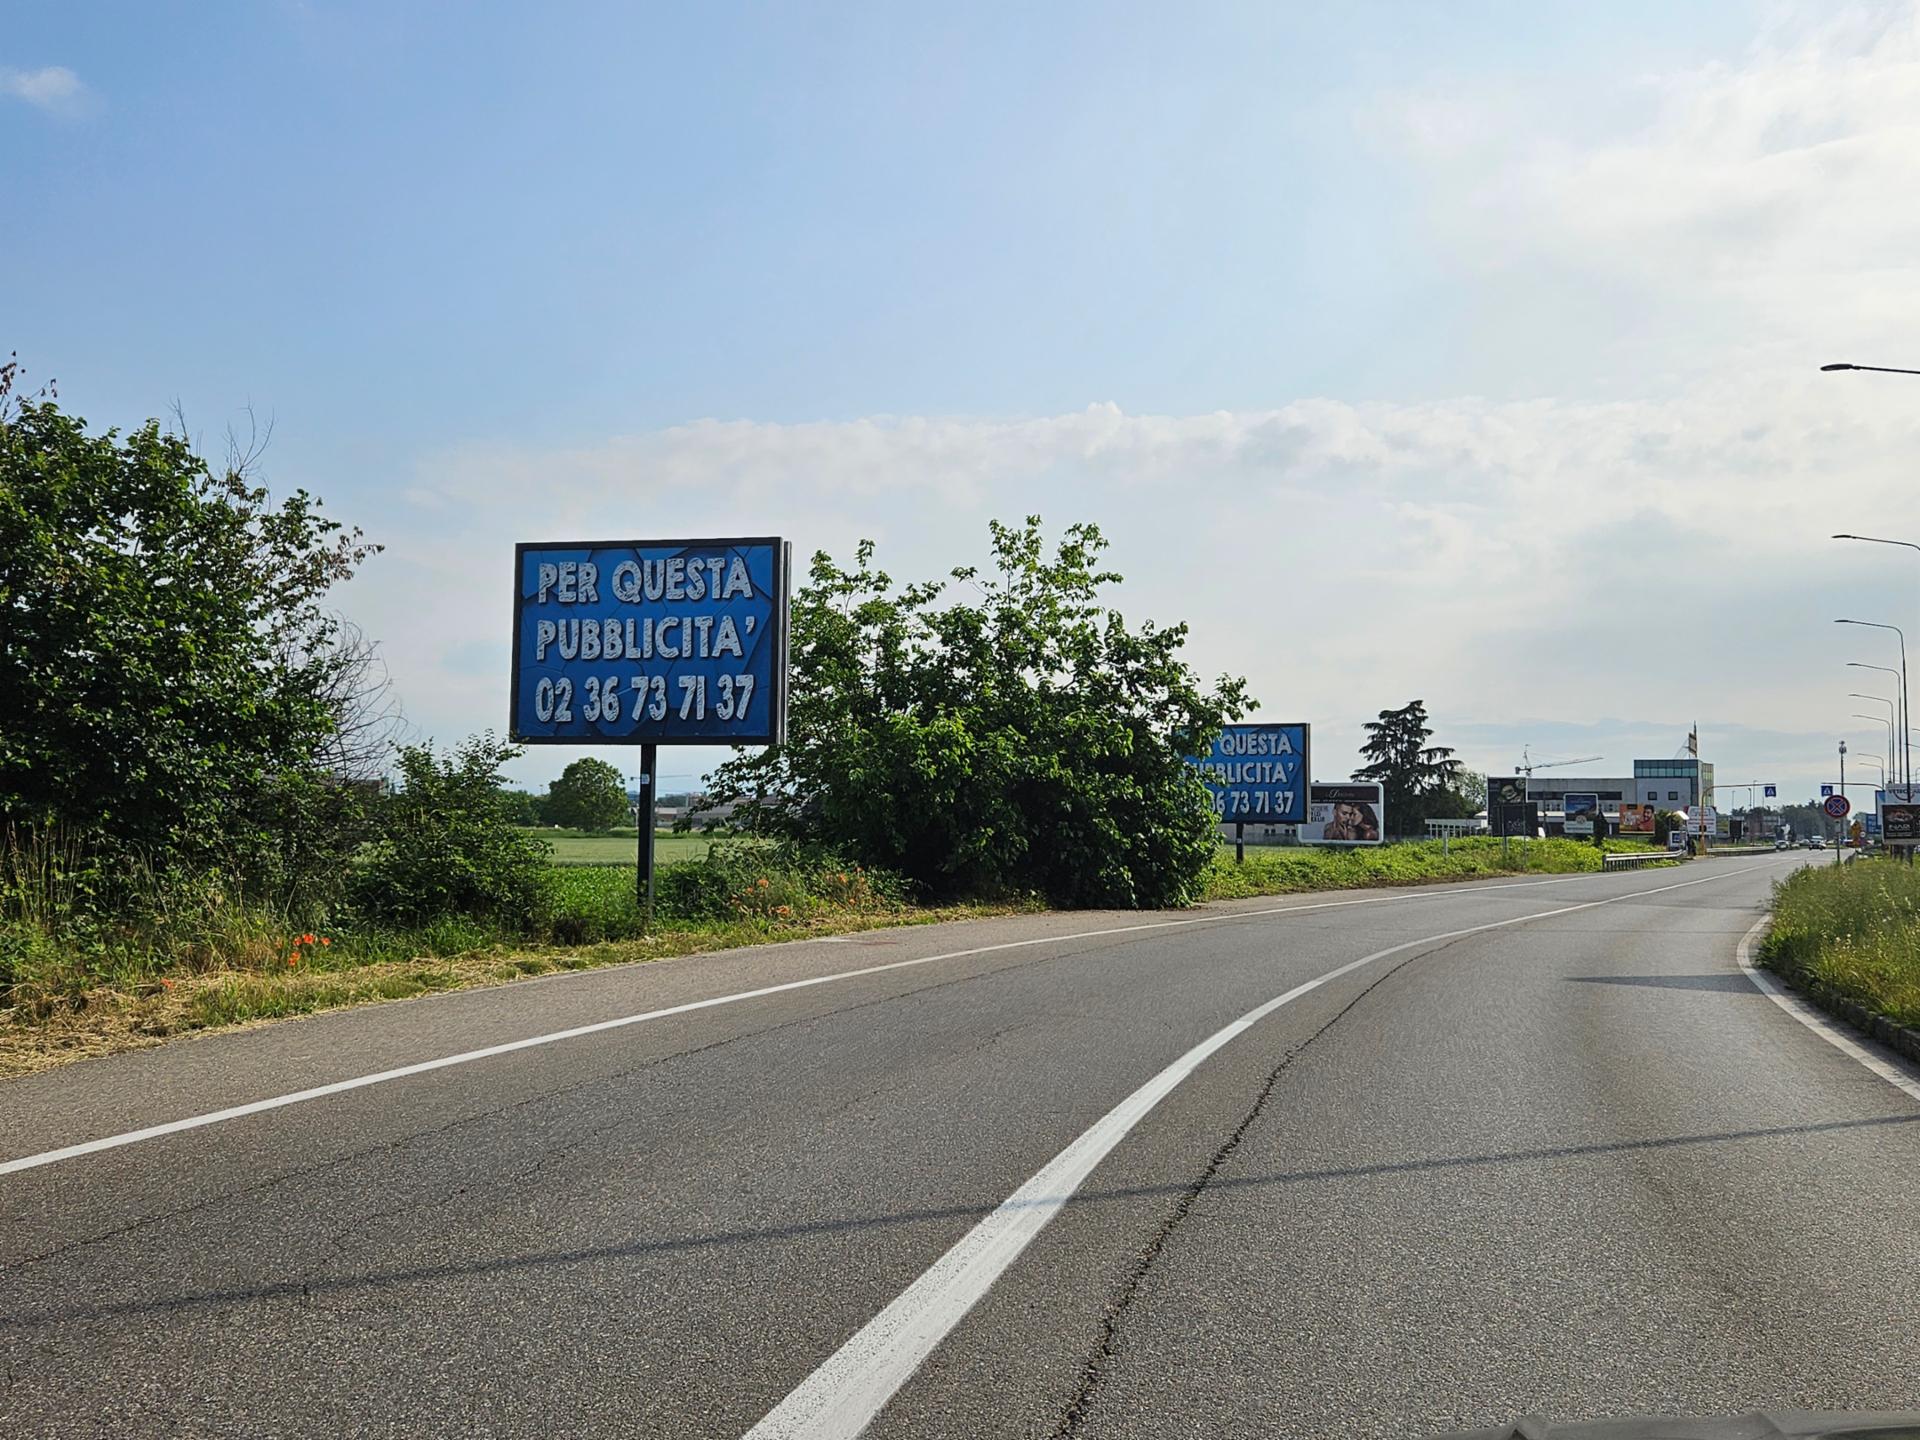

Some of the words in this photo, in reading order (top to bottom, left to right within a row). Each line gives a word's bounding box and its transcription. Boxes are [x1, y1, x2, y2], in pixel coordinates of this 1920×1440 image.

[538, 561, 598, 603] PER
[612, 557, 753, 603] QUESTA
[536, 615, 755, 661] PUBBLICITA'
[535, 676, 573, 722] 02
[583, 675, 619, 722] 36
[631, 675, 667, 721] 73
[678, 675, 705, 720] 71
[715, 674, 754, 721] 37
[1219, 733, 1292, 756] QUESTA
[1231, 791, 1250, 814] 73
[1255, 791, 1269, 814] 71
[1274, 791, 1294, 814] 37
